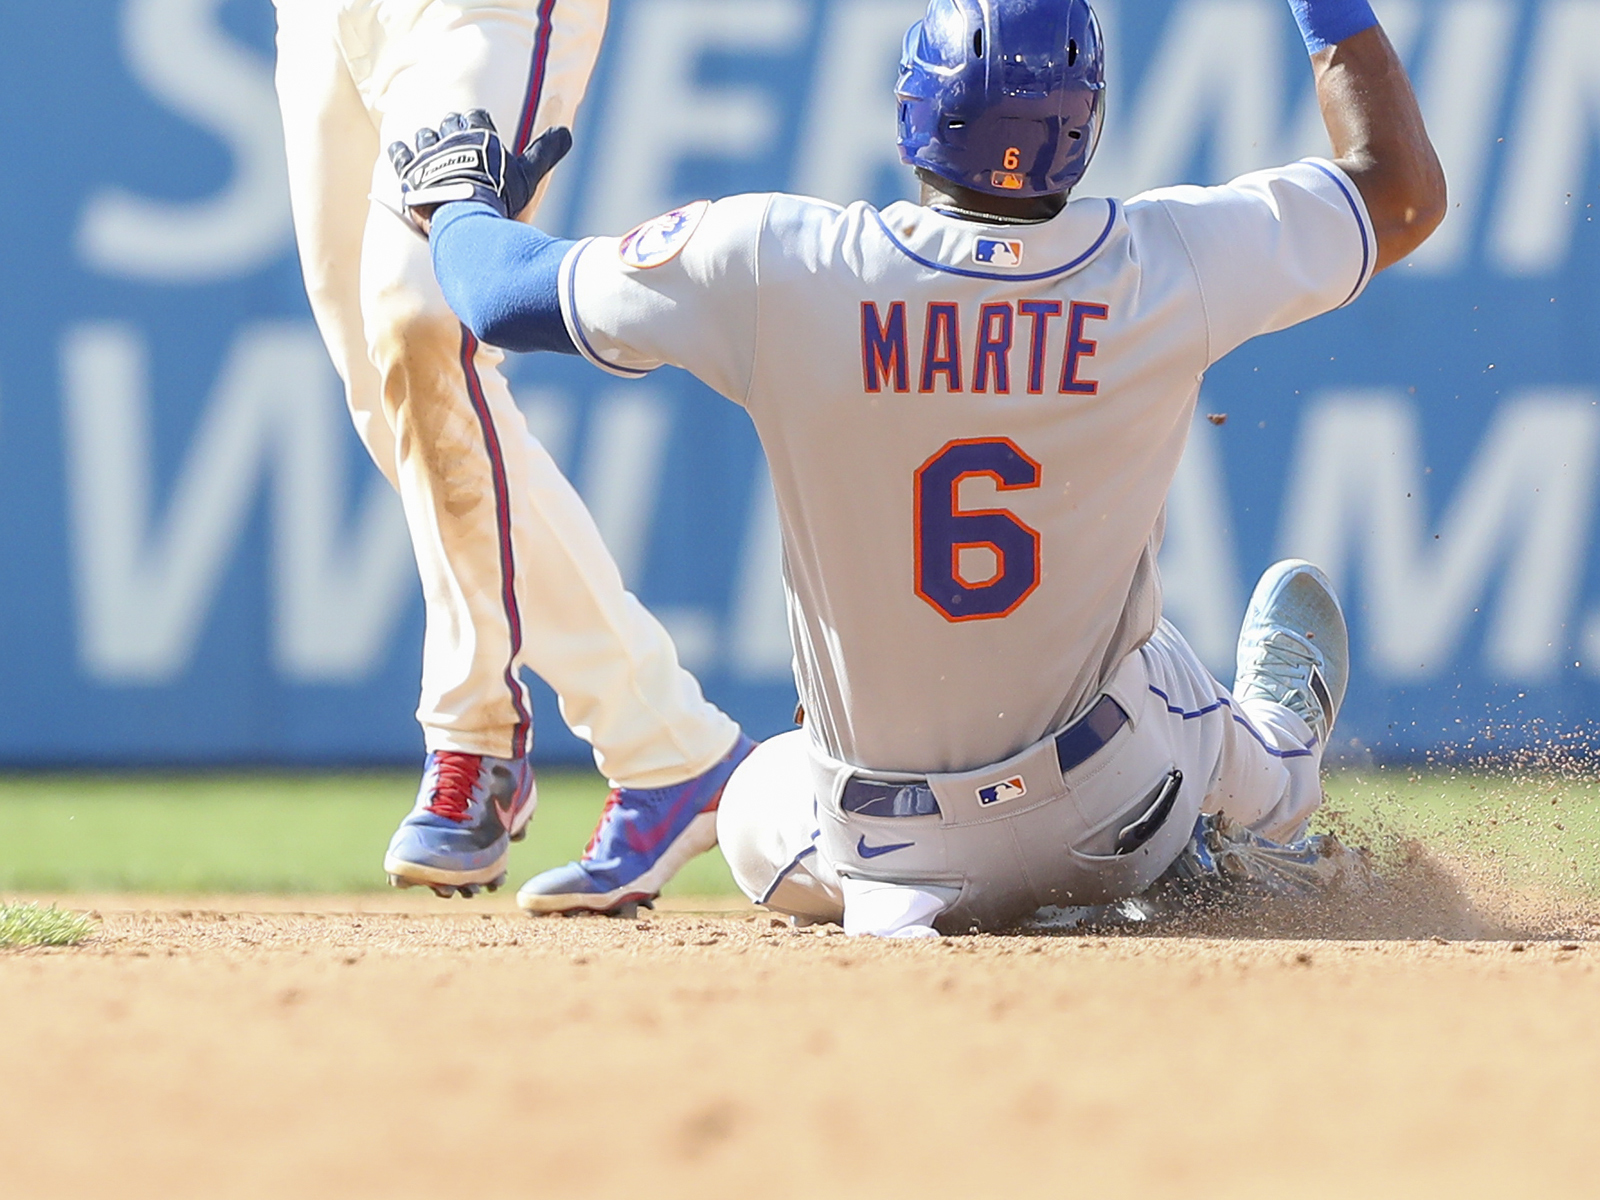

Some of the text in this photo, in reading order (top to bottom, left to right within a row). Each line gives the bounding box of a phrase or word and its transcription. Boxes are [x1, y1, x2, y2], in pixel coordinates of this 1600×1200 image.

[1003, 147, 1020, 170] 6
[861, 299, 1109, 395] MARTE
[913, 436, 1042, 623] 6
